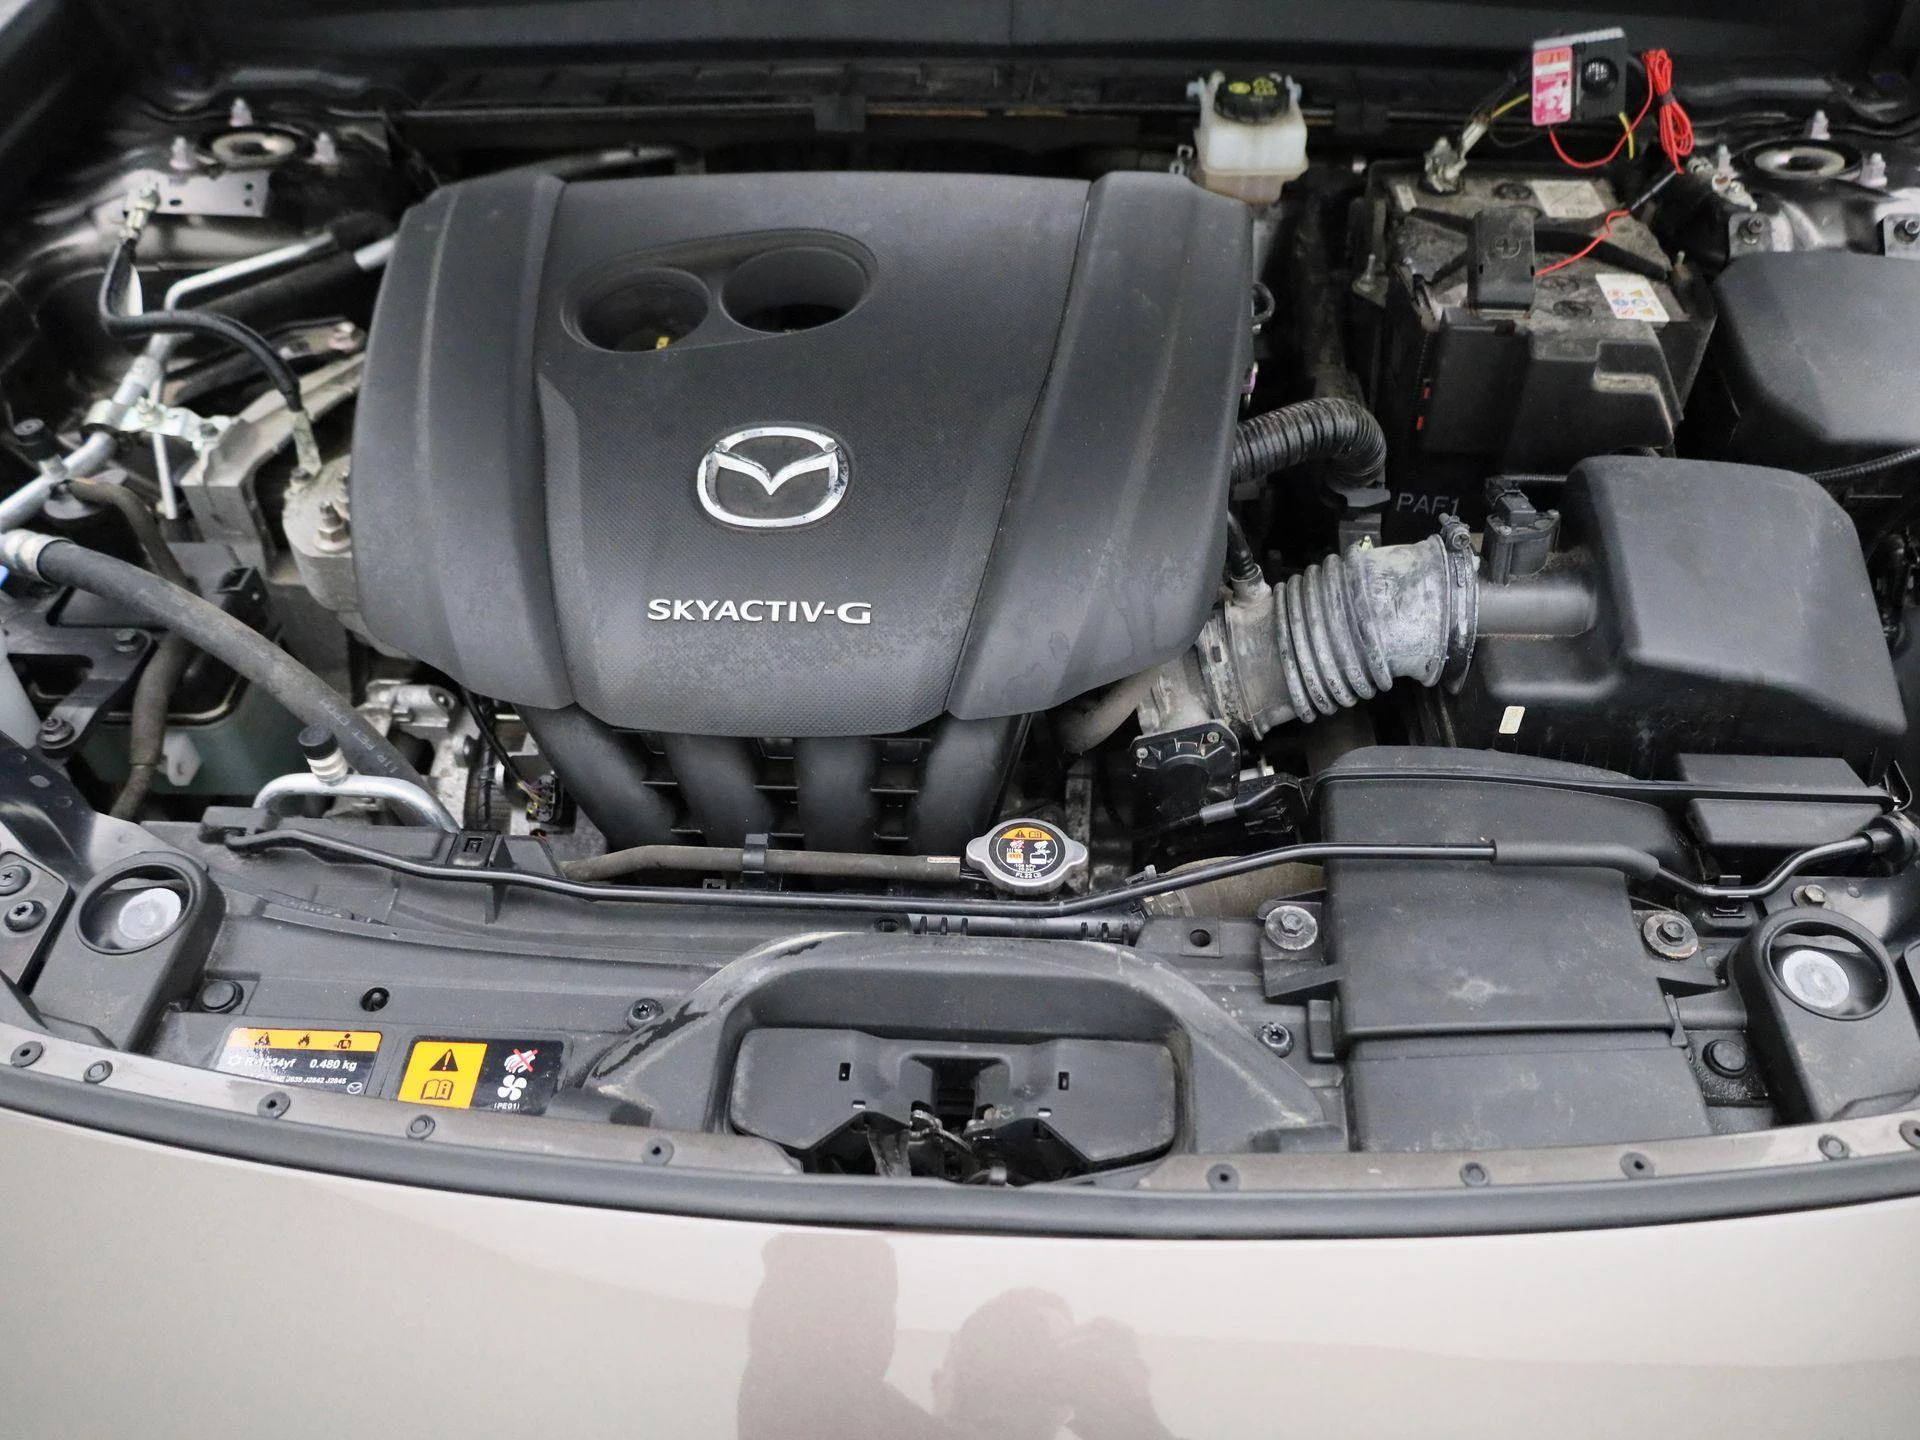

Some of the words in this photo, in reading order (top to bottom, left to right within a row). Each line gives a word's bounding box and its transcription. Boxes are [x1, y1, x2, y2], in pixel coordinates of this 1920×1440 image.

[1396, 492, 1460, 516] PAF1
[647, 598, 872, 624] SKYACTIV-G
[351, 730, 376, 751] PET
[309, 1058, 341, 1069] 0.480
[342, 1059, 358, 1072] kg
